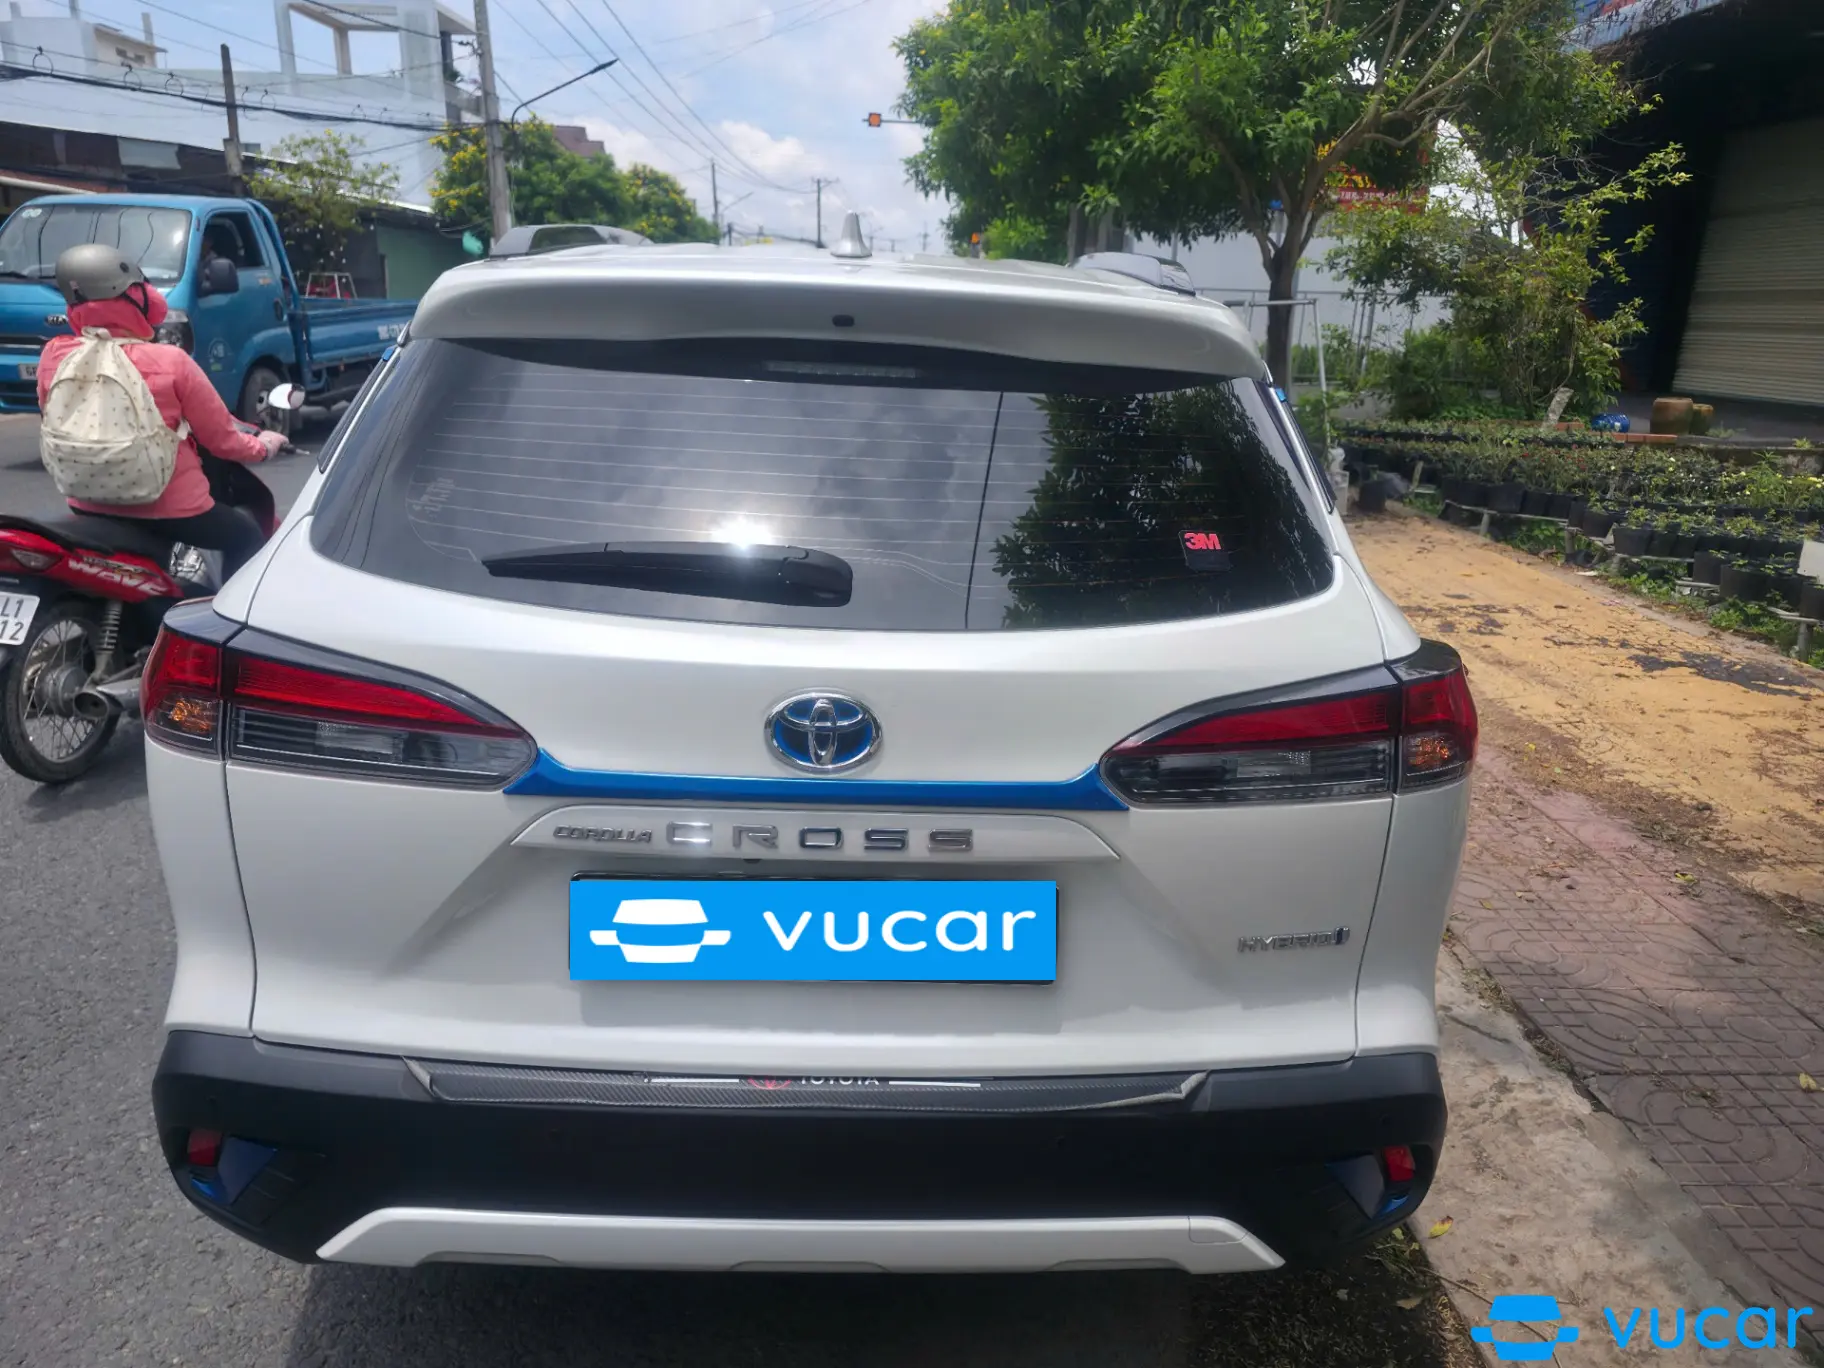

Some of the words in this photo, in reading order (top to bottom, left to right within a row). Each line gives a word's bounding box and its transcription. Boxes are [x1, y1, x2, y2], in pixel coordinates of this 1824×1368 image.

[47, 314, 68, 325] KIA
[1184, 532, 1222, 550] 3M
[68, 558, 168, 596] WAVE
[1, 597, 24, 618] L1
[0, 620, 24, 641] 12
[553, 824, 653, 844] COROLLA
[666, 821, 973, 852] CROSS
[1237, 931, 1333, 953] HYBRID
